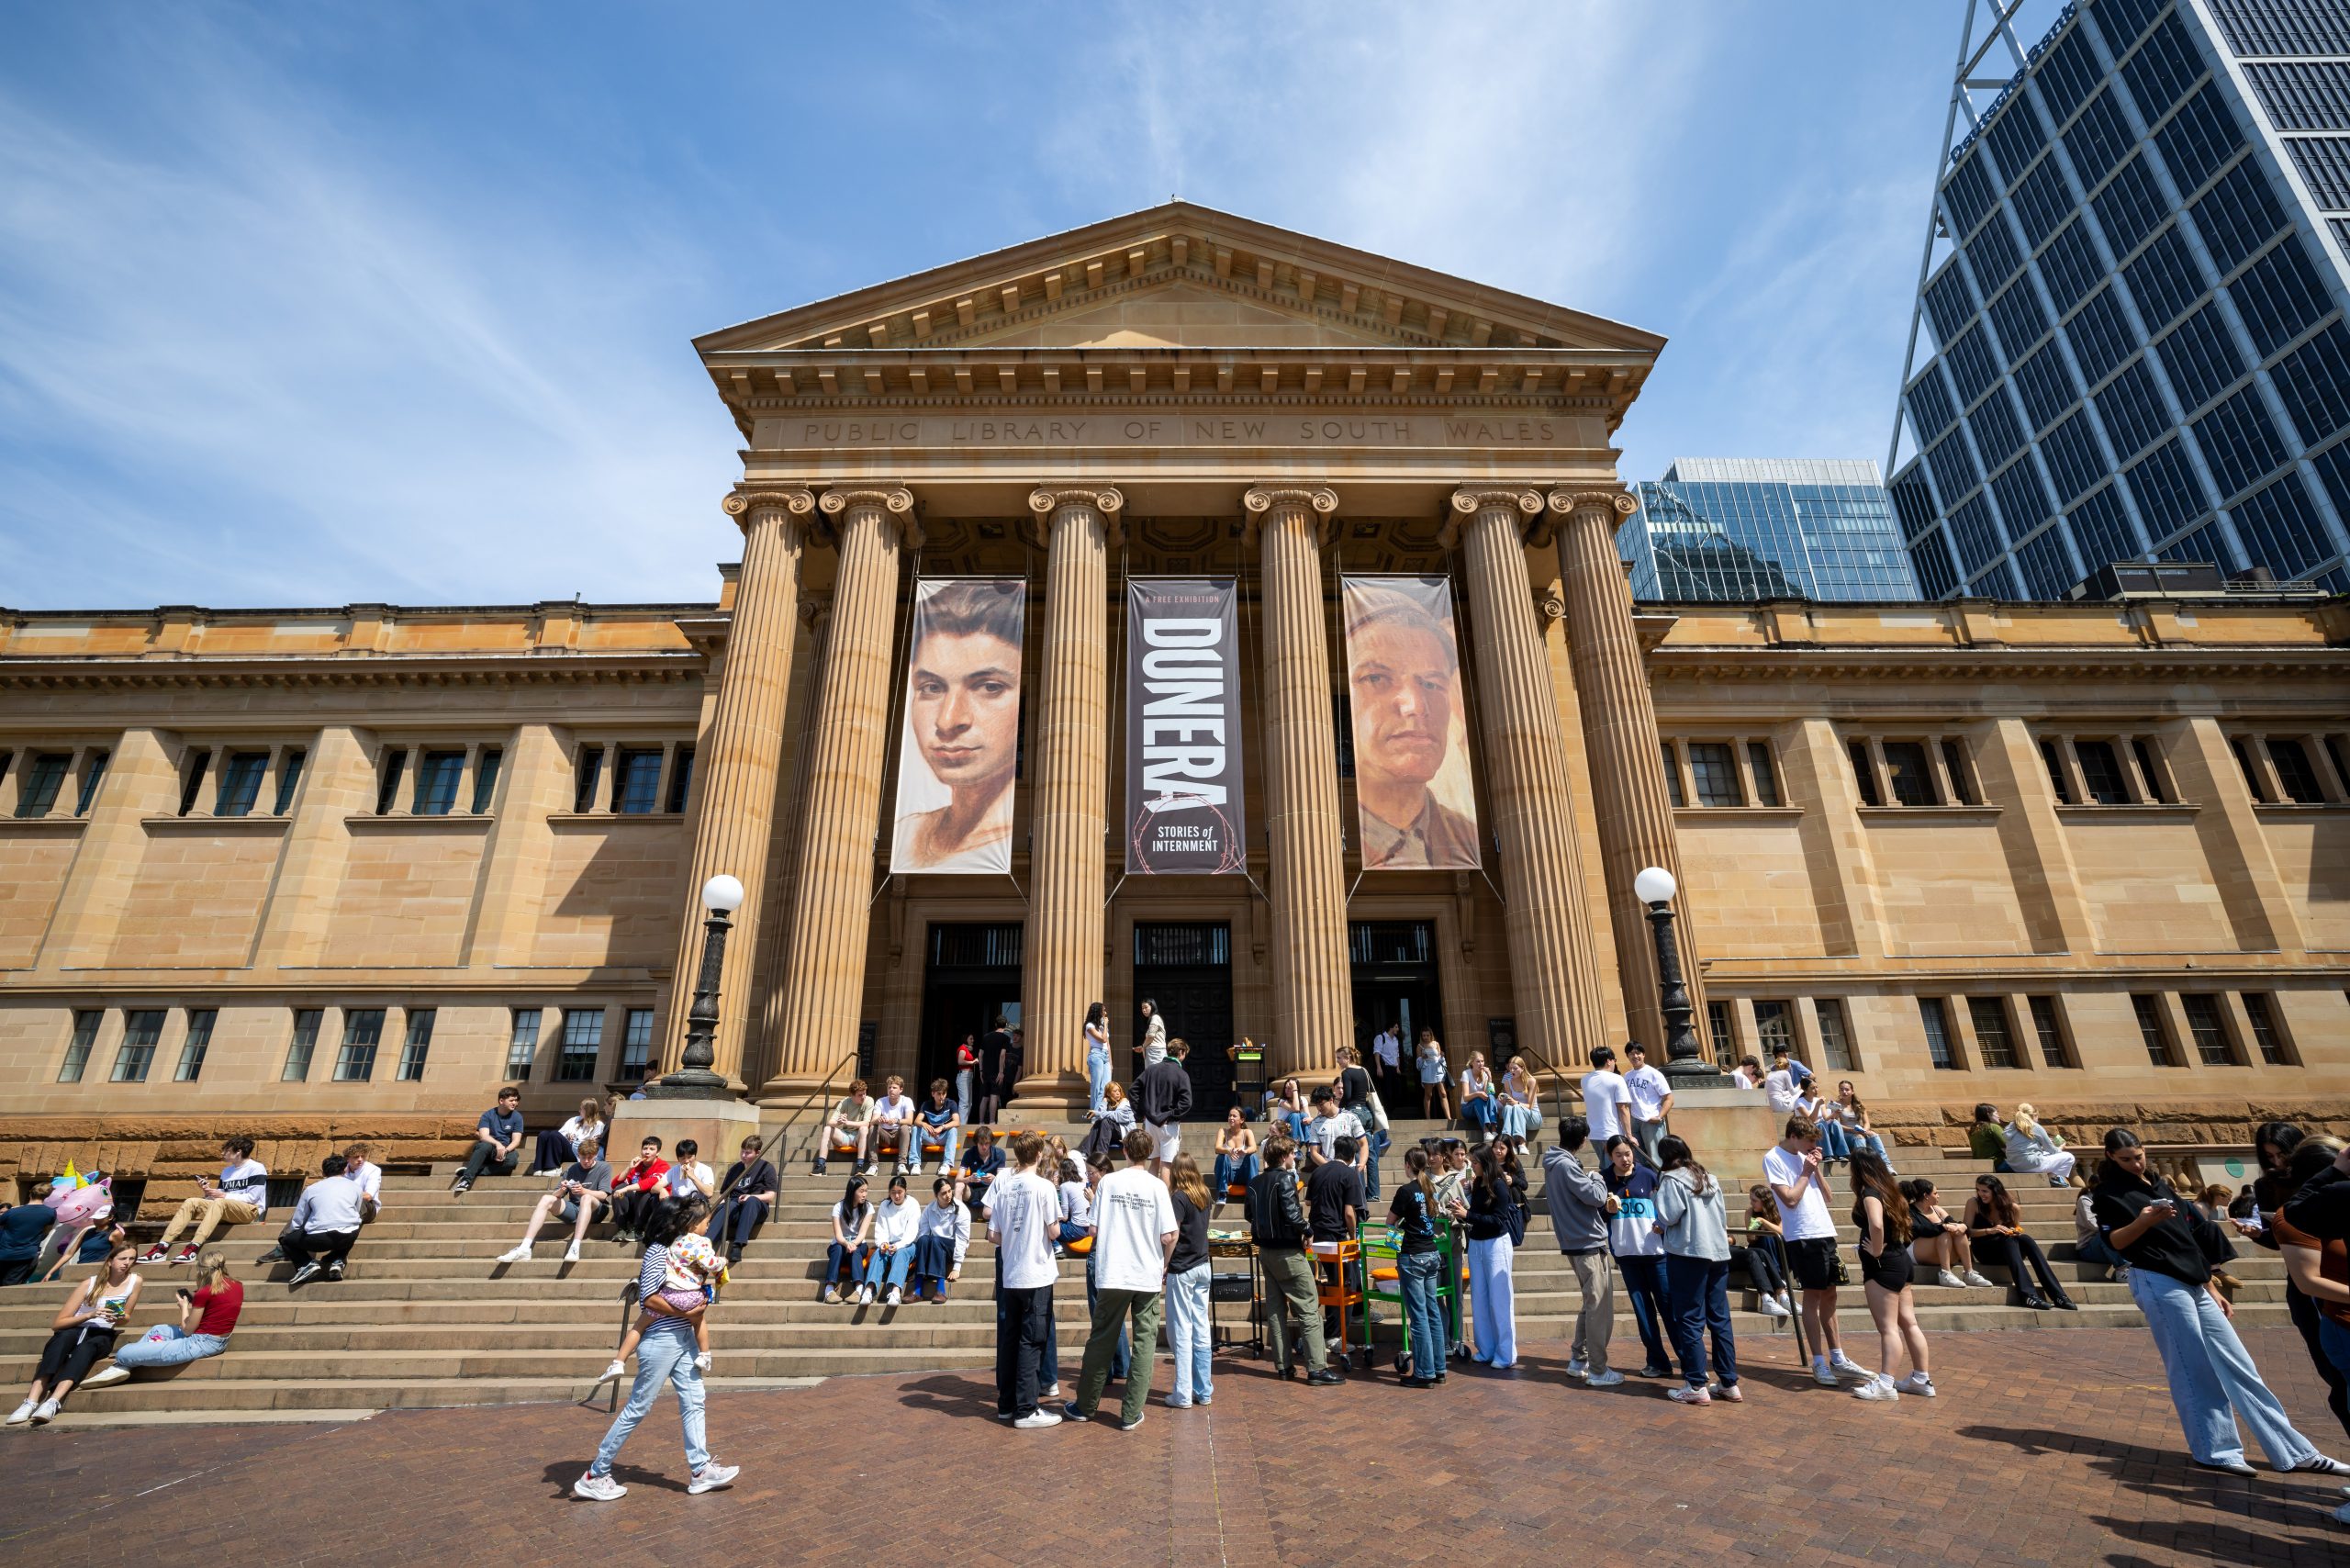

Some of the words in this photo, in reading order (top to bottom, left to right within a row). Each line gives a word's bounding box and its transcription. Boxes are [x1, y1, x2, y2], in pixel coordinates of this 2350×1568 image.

[1950, 67, 2026, 165] Deutsche
[2027, 1, 2077, 65] Bank
[804, 422, 917, 442] PUBLIC
[952, 421, 1087, 441] LIBRARY
[1124, 421, 1161, 440] OF
[1195, 421, 1266, 440] NEW
[1300, 421, 1411, 440] SOUTH
[1447, 422, 1554, 441] WALES
[1153, 595, 1171, 603] FREE
[1174, 595, 1220, 603] EXHIBITION
[1142, 618, 1226, 813] DUNERA
[1158, 825, 1200, 838] STORIES
[1203, 825, 1214, 840] of
[1152, 840, 1218, 852] INTERNMENT
[1621, 1202, 1645, 1215] OLO
